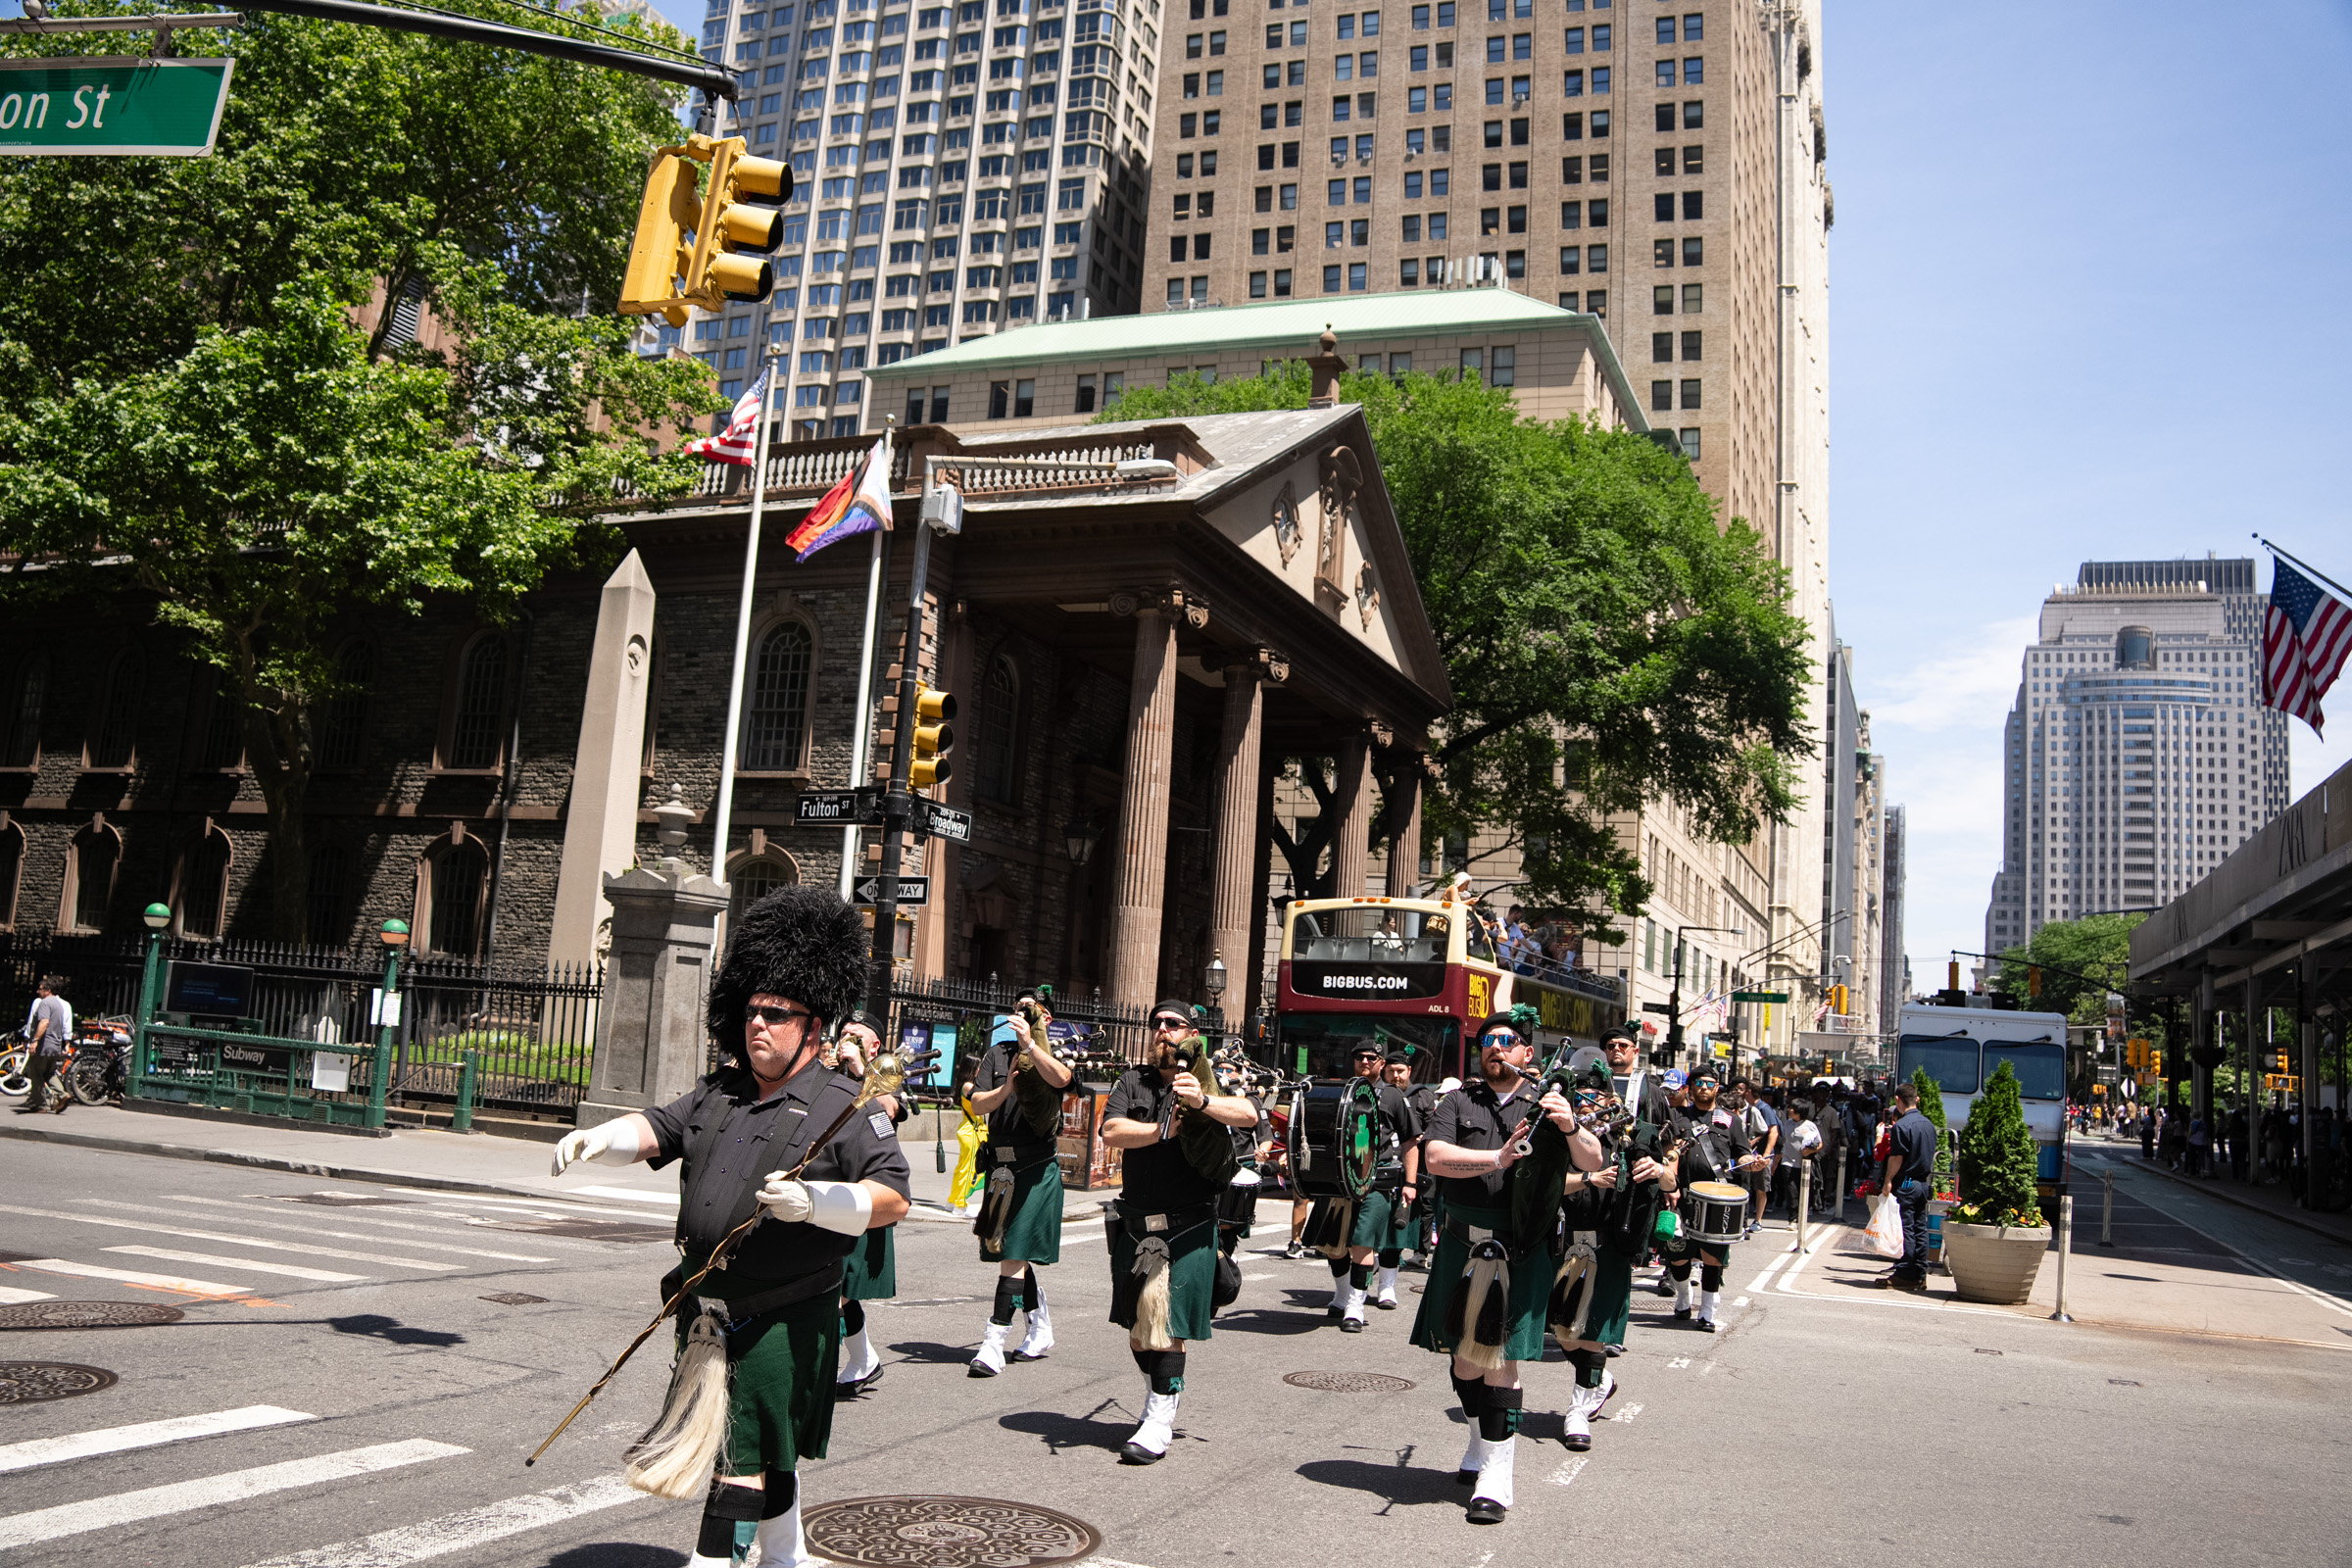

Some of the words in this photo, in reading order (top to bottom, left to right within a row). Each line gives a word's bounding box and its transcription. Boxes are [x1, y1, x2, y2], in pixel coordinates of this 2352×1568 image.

[66, 84, 111, 128] St
[801, 801, 839, 817] Fulton
[842, 800, 850, 809] ST
[930, 811, 967, 838] Broadway
[897, 885, 919, 896] WAY
[1323, 975, 1408, 990] BIGBUS.COM
[1469, 973, 1481, 997] BIG
[1428, 1004, 1443, 1013] ADL
[1444, 1004, 1449, 1013] 8
[1468, 997, 1481, 1018] BUS
[1747, 994, 1765, 1003] Vesey
[933, 1010, 954, 1021] CHAPEL
[1541, 990, 1592, 1035] BIGBUS.COM
[222, 1045, 266, 1065] Subway
[1722, 1205, 1731, 1234] DSNY
